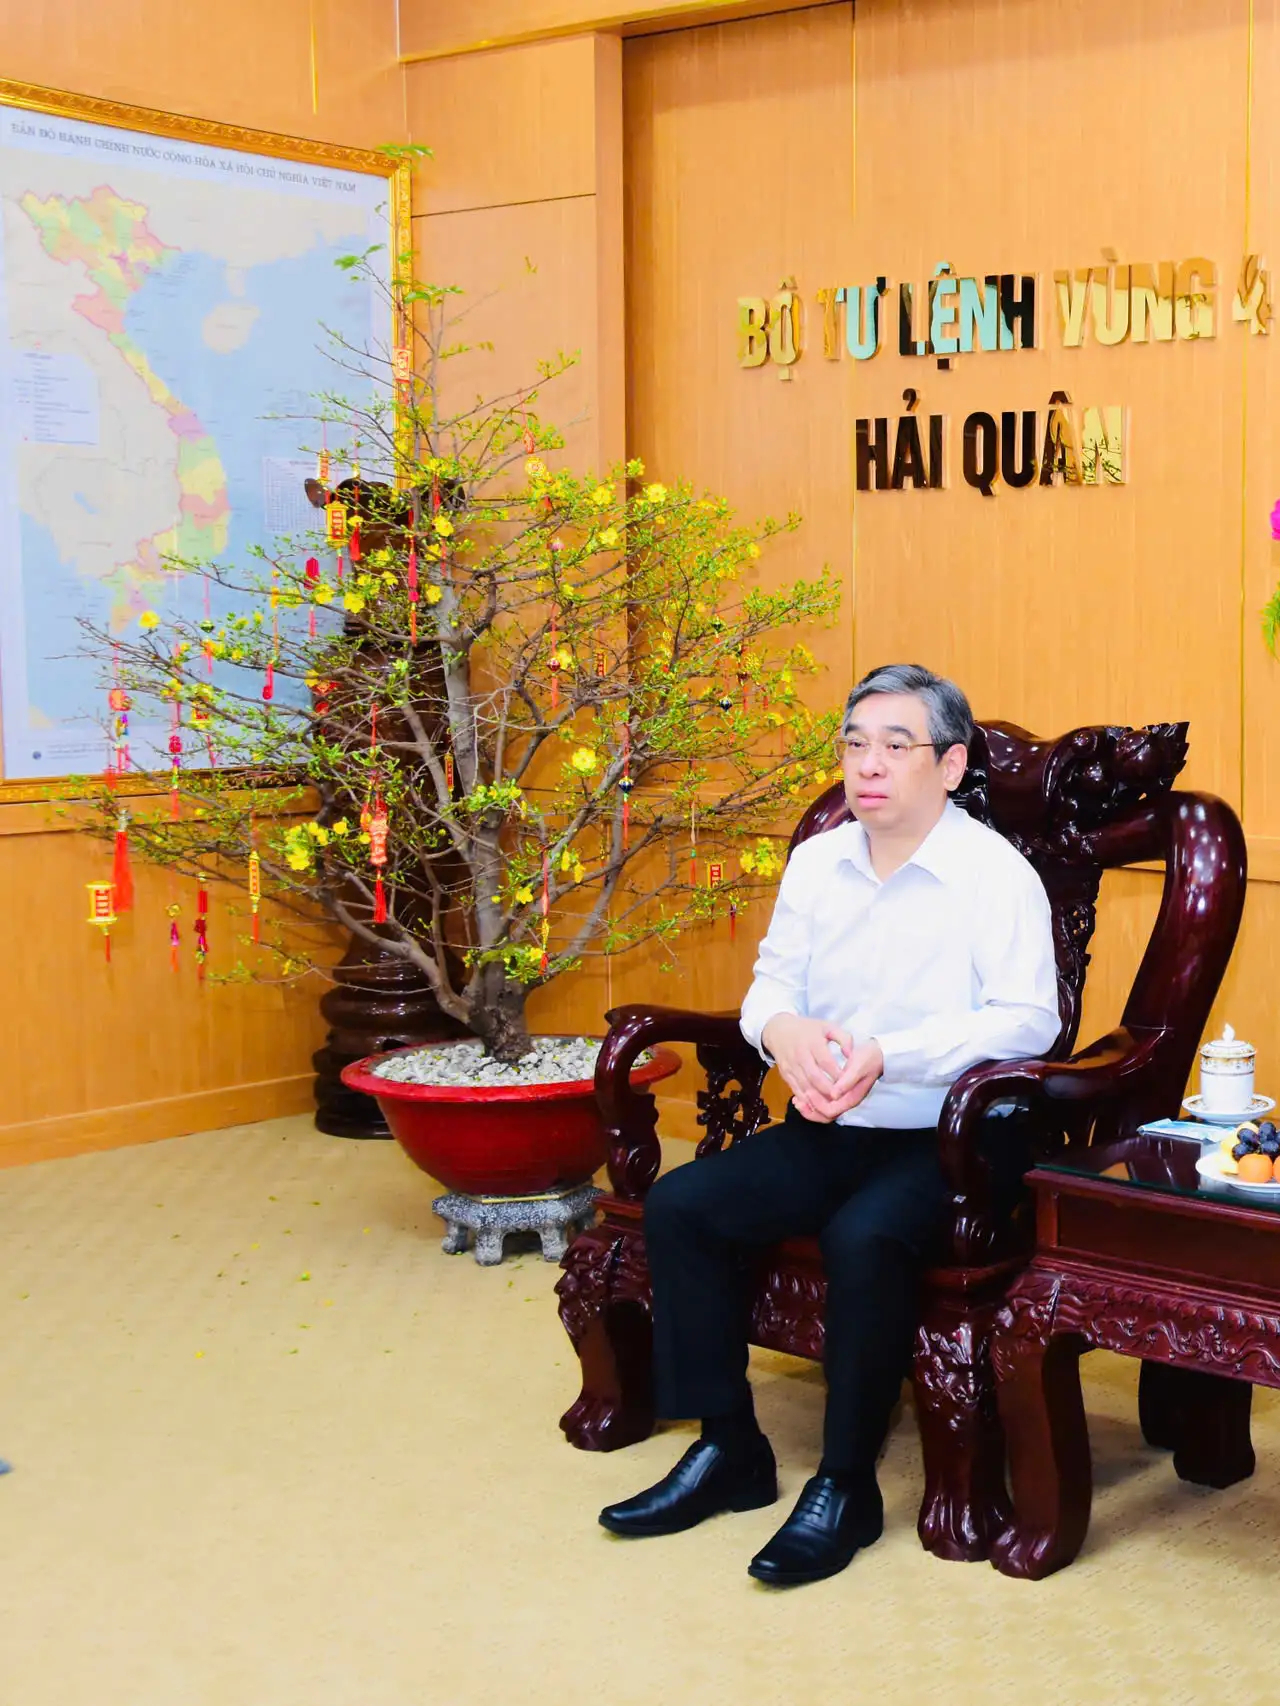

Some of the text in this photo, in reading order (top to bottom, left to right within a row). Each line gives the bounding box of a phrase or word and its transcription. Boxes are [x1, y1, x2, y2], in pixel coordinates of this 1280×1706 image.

[335, 180, 356, 193] NAM
[737, 247, 1271, 381] BỘ TƯ LỆNH VÙNG 4
[856, 388, 1125, 496] HẢI QUÂN
